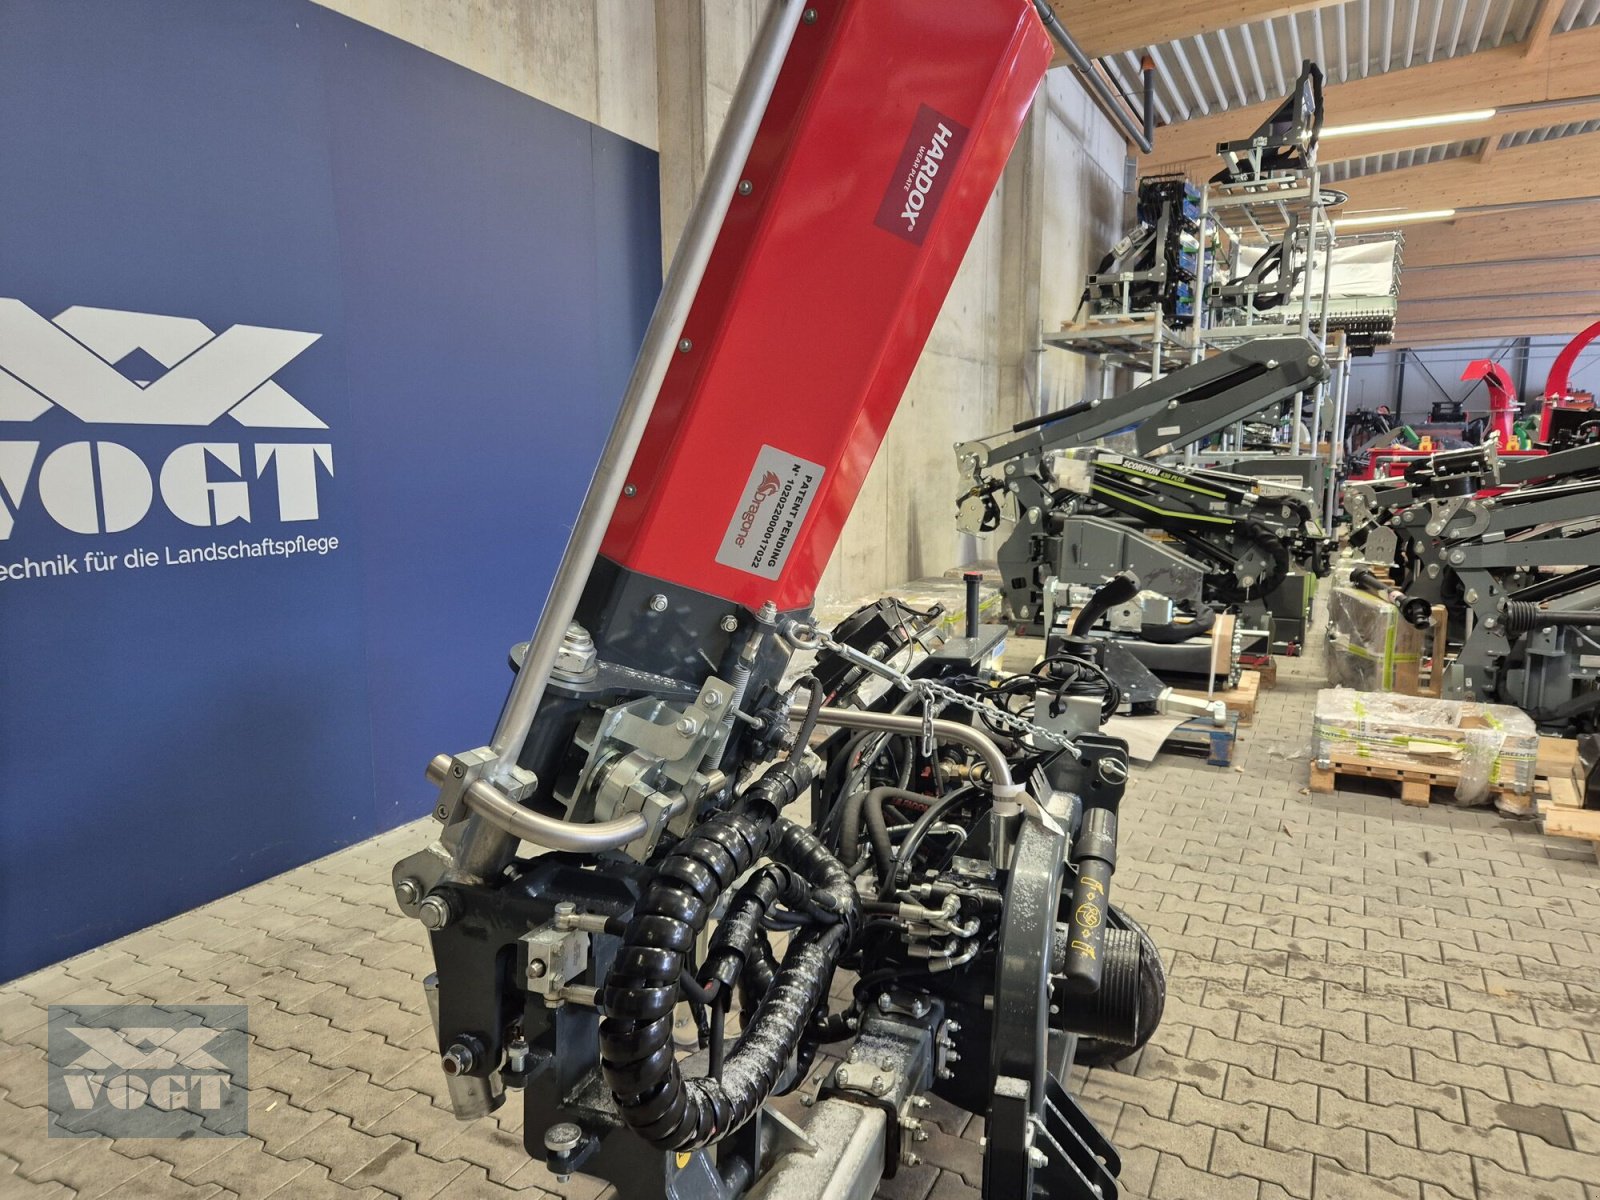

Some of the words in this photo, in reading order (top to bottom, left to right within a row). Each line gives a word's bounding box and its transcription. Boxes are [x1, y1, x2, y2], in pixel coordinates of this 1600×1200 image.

[901, 122, 953, 226] HARDOX
[912, 145, 926, 169] WEAR
[903, 167, 917, 192] PLATE
[1122, 460, 1161, 476] SCORPION
[789, 474, 813, 519] PATENT
[735, 491, 767, 548] Dragone
[84, 551, 118, 573] für
[124, 548, 159, 569] die
[165, 535, 339, 566] Landschaftspflege
[767, 520, 793, 567] PENDING
